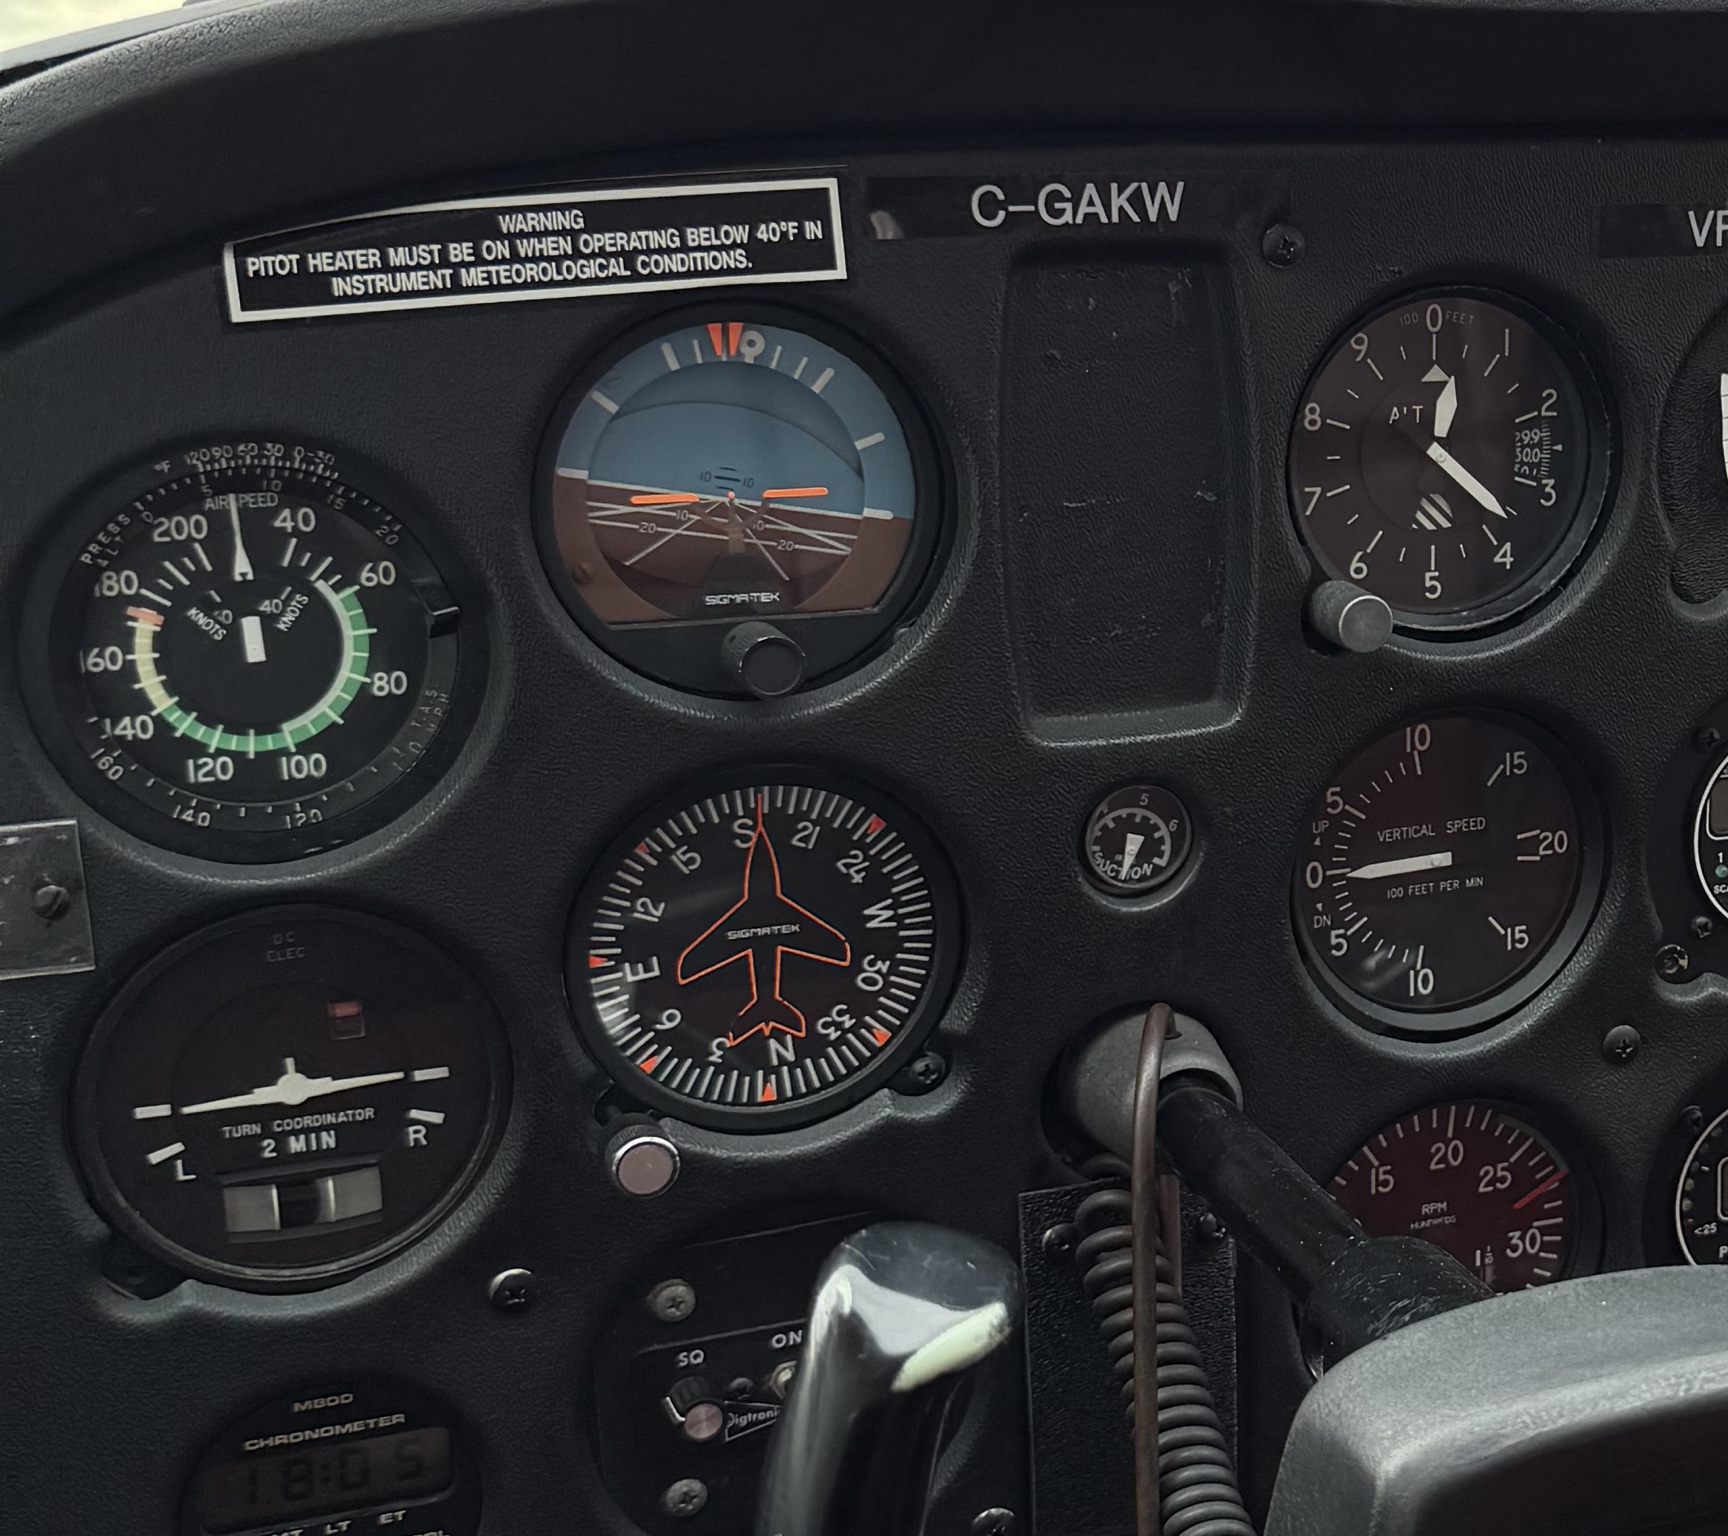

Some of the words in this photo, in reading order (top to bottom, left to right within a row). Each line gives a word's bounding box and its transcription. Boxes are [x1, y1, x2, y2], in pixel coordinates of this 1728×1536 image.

[971, 181, 1184, 228] C-GAKW
[499, 210, 585, 233] WARNING
[246, 253, 301, 278] PITOT
[307, 249, 382, 273] HEATER
[389, 244, 442, 266] MUST
[449, 243, 478, 263] BE
[482, 240, 511, 262] ON
[516, 235, 573, 260] WHEN
[579, 228, 681, 255] OPERATING
[686, 224, 751, 246] BELOW
[756, 222, 798, 243] 40°F
[803, 219, 823, 240] IN
[332, 268, 453, 297] INSTRUMENT
[461, 256, 631, 286] METEOROLOGICAL
[636, 247, 754, 274] CONDITIONS.
[1426, 304, 1443, 332] 0
[1350, 332, 1369, 361] 9
[1541, 389, 1557, 416] 2
[1304, 402, 1322, 431] 8
[1304, 487, 1322, 516] 7
[1540, 479, 1556, 506] 3
[153, 514, 208, 541] 200
[274, 508, 316, 532] 40
[1350, 551, 1368, 579] 6
[1493, 542, 1514, 569] 4
[360, 561, 396, 586] 60
[1425, 572, 1441, 599] 5
[279, 593, 309, 631] KNOTS
[373, 672, 408, 696] 80
[1405, 723, 1431, 753] 10
[188, 758, 234, 782] 120
[280, 754, 327, 779] 100
[1504, 753, 1528, 776] 15
[1326, 787, 1344, 813] 5
[733, 818, 758, 847] S
[1312, 820, 1330, 833] UP
[1377, 825, 1436, 842] VERTICAL
[1446, 818, 1486, 833] SPEED
[1539, 830, 1569, 855] 20
[836, 850, 870, 884] 24
[1305, 862, 1324, 888] 0
[1387, 887, 1405, 899] 100
[1408, 883, 1435, 896] FEET
[1440, 880, 1461, 892] PER
[1464, 876, 1484, 890] MIN
[863, 898, 898, 928] W
[623, 956, 661, 982] E
[857, 953, 891, 991] 30
[817, 1004, 856, 1041] 33
[768, 1035, 796, 1066] N
[222, 1122, 262, 1137] TURN
[273, 1108, 375, 1132] COORDINATOR
[260, 1139, 277, 1159] 2
[289, 1130, 337, 1154] MIN
[407, 1126, 428, 1147] R
[1430, 1139, 1464, 1170] 20
[174, 1159, 196, 1181] L
[1370, 1166, 1394, 1195] 15
[1479, 1162, 1512, 1192] 25
[1422, 1201, 1448, 1214] RPM
[1506, 1228, 1541, 1258] 30
[678, 1350, 705, 1366] SQ
[243, 1413, 406, 1450] CHRONOMETER
[325, 1521, 351, 1534] LT
[379, 1511, 406, 1524] ET
